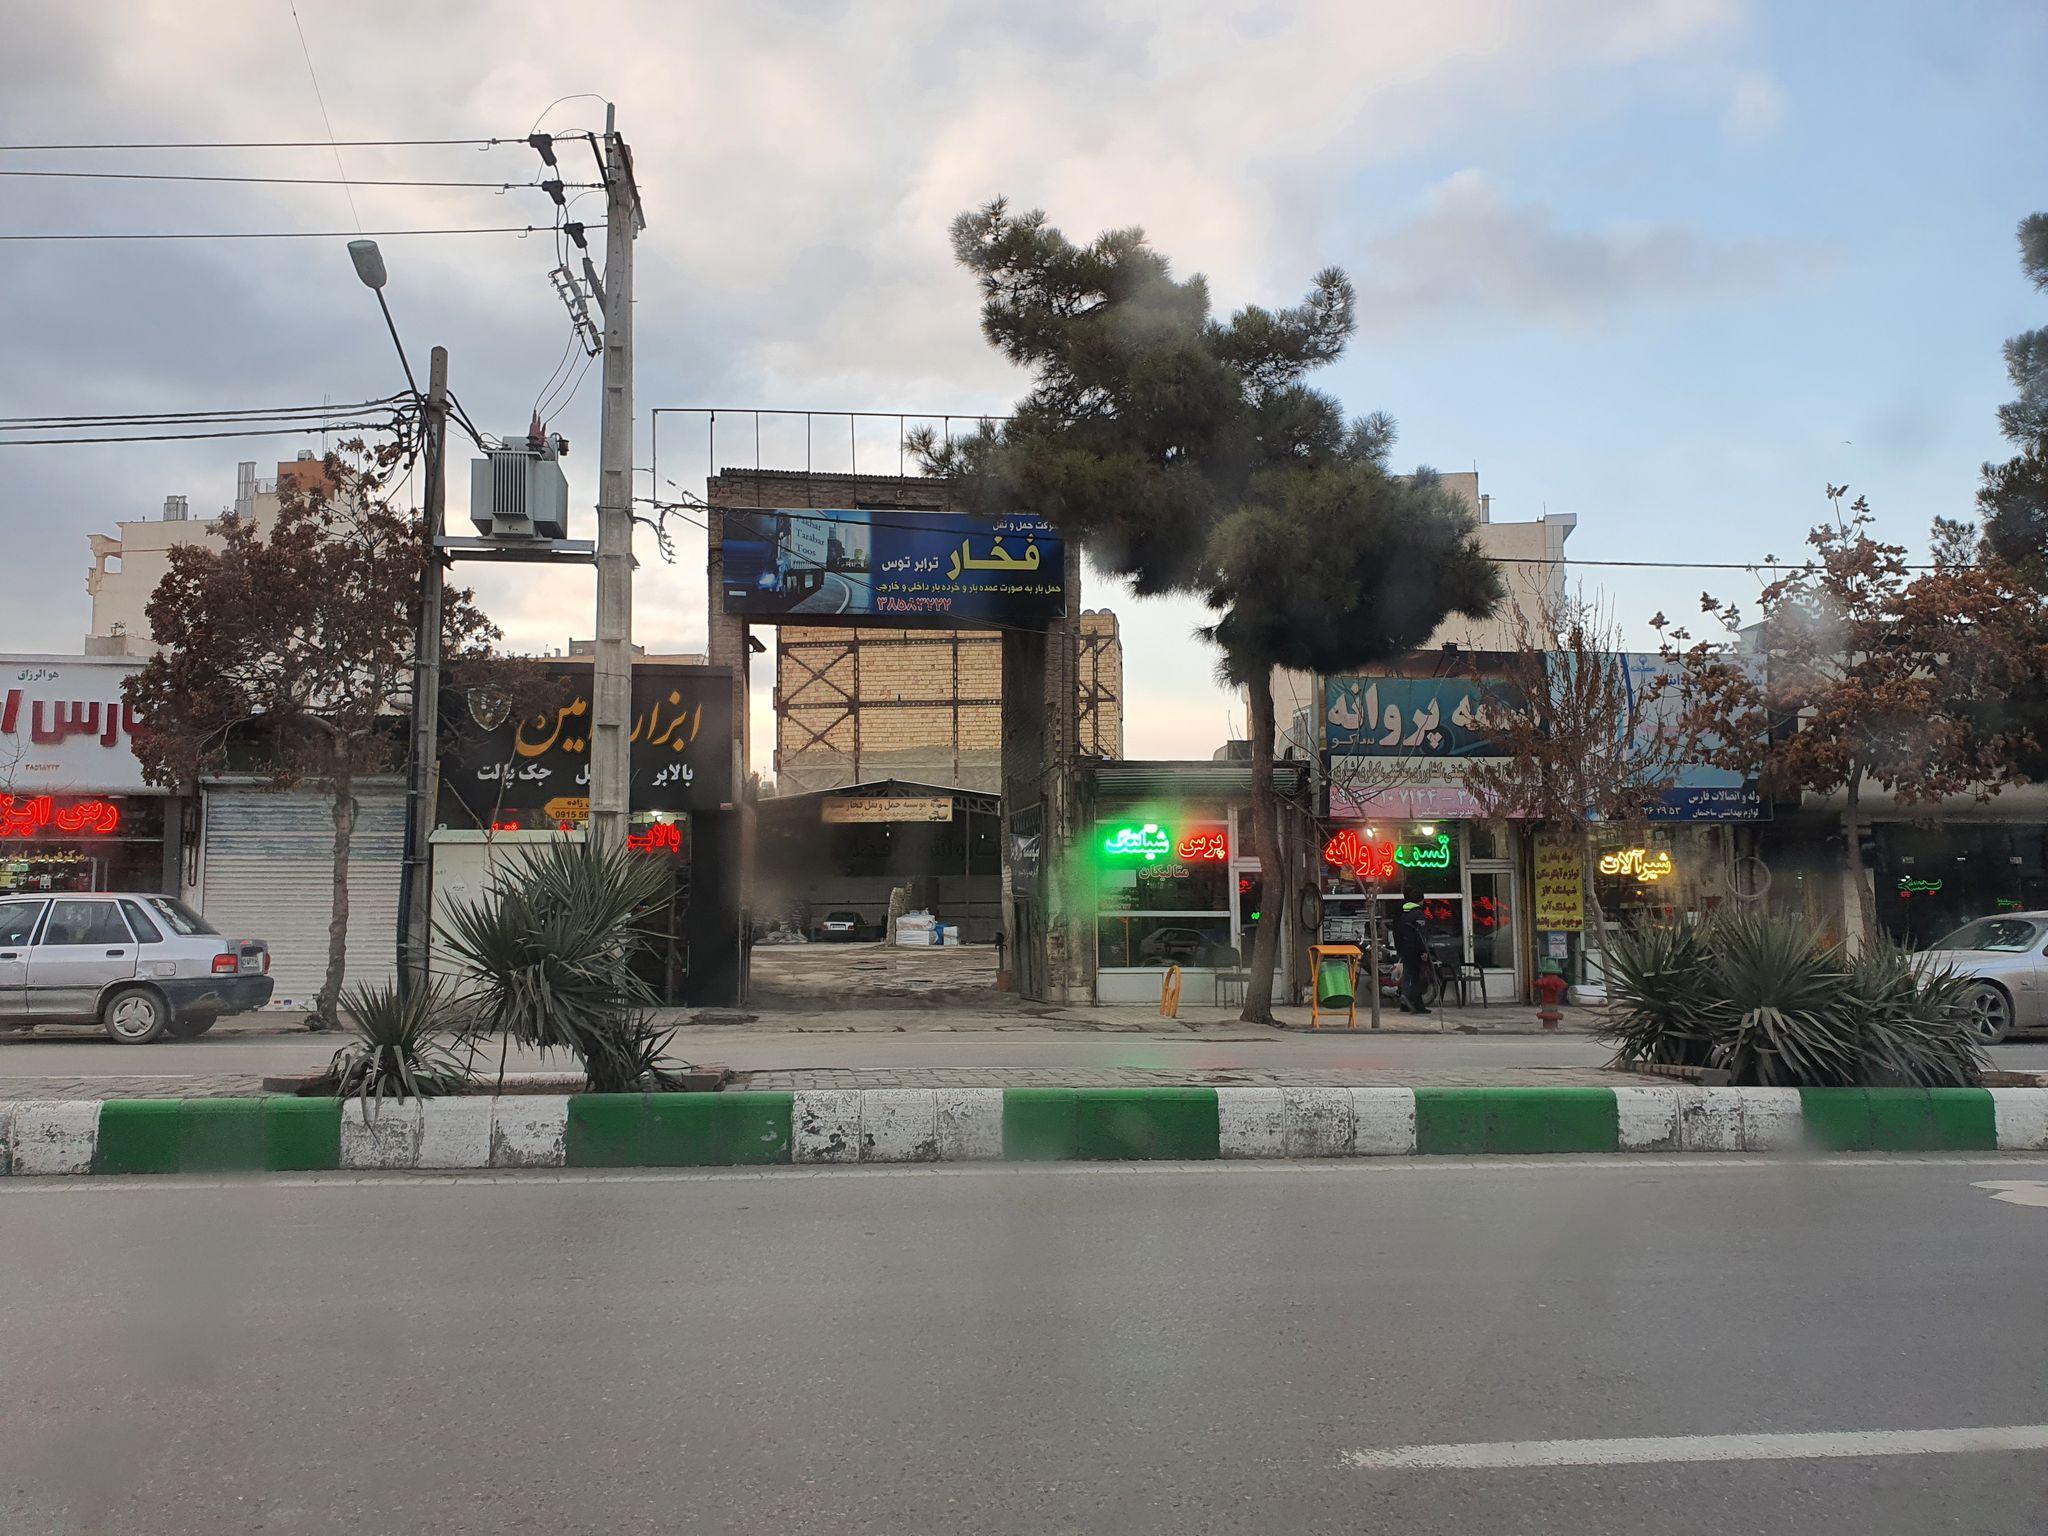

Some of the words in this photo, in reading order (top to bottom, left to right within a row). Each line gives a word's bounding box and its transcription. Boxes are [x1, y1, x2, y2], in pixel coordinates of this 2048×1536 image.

[1009, 522, 1015, 531] و
[1015, 521, 1034, 531] حمل
[796, 544, 817, 557] Toos
[945, 532, 1040, 580] فخار
[881, 556, 911, 571] توس
[914, 556, 939, 572] ترابر
[908, 582, 929, 593] داخلی
[1000, 584, 1023, 593] صورت
[1024, 586, 1033, 594] به
[1034, 584, 1044, 594] بار
[1044, 585, 1062, 594] حمل
[17, 669, 46, 681] الرزاق
[48, 672, 60, 681] هو
[1327, 682, 1443, 750] پروانه
[515, 697, 593, 758] مین
[518, 763, 552, 786] جک
[651, 763, 694, 787] بالابر
[1748, 790, 1761, 804] وله
[884, 800, 900, 811] حمل
[555, 810, 577, 819] 0915
[1178, 833, 1226, 860] پرس
[1393, 834, 1450, 868] تسمه
[1324, 830, 1394, 877] پروانه
